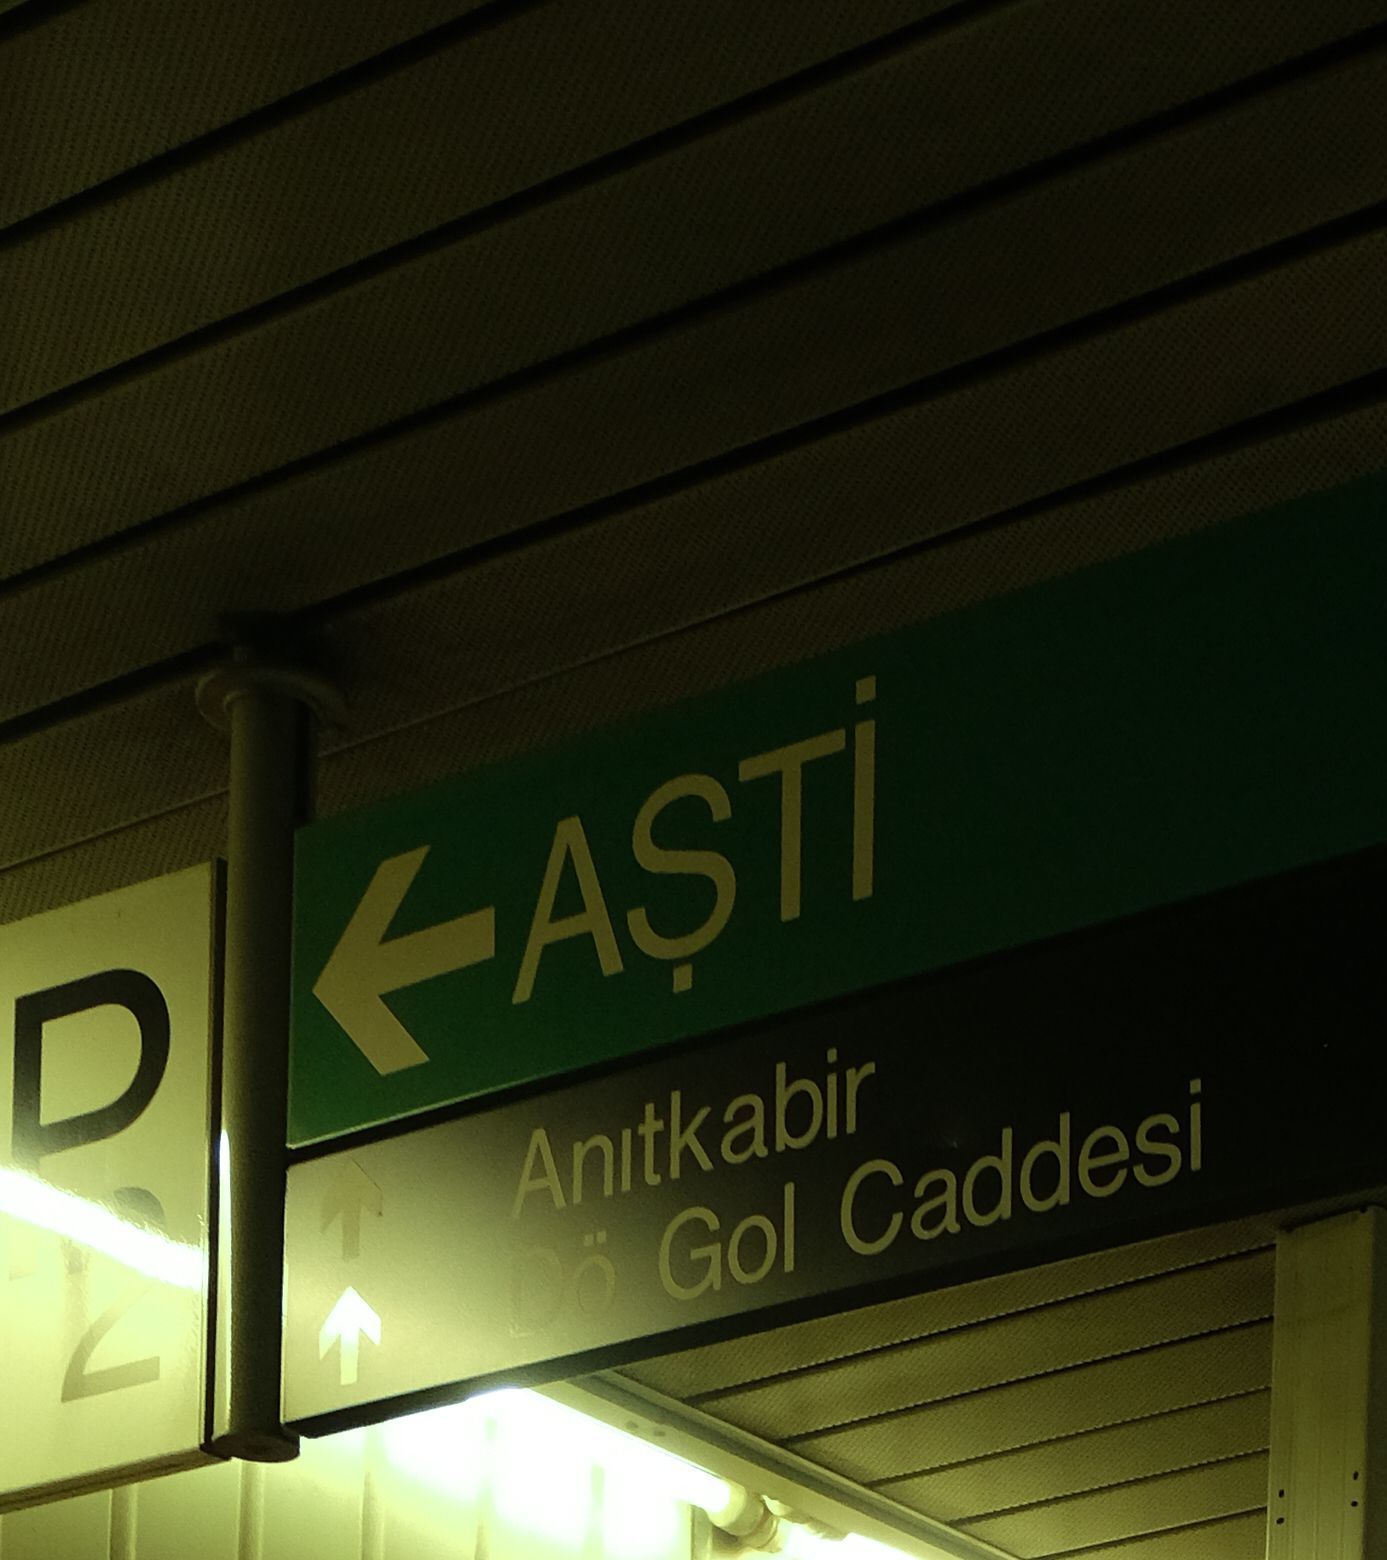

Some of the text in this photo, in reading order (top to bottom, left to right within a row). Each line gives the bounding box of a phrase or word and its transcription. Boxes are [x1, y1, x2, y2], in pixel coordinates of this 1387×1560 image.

[512, 674, 878, 1005] AŞTİ
[513, 1045, 877, 1219] Anıtkabir
[659, 1180, 797, 1301] Gol
[840, 1077, 1203, 1258] Caddesi
